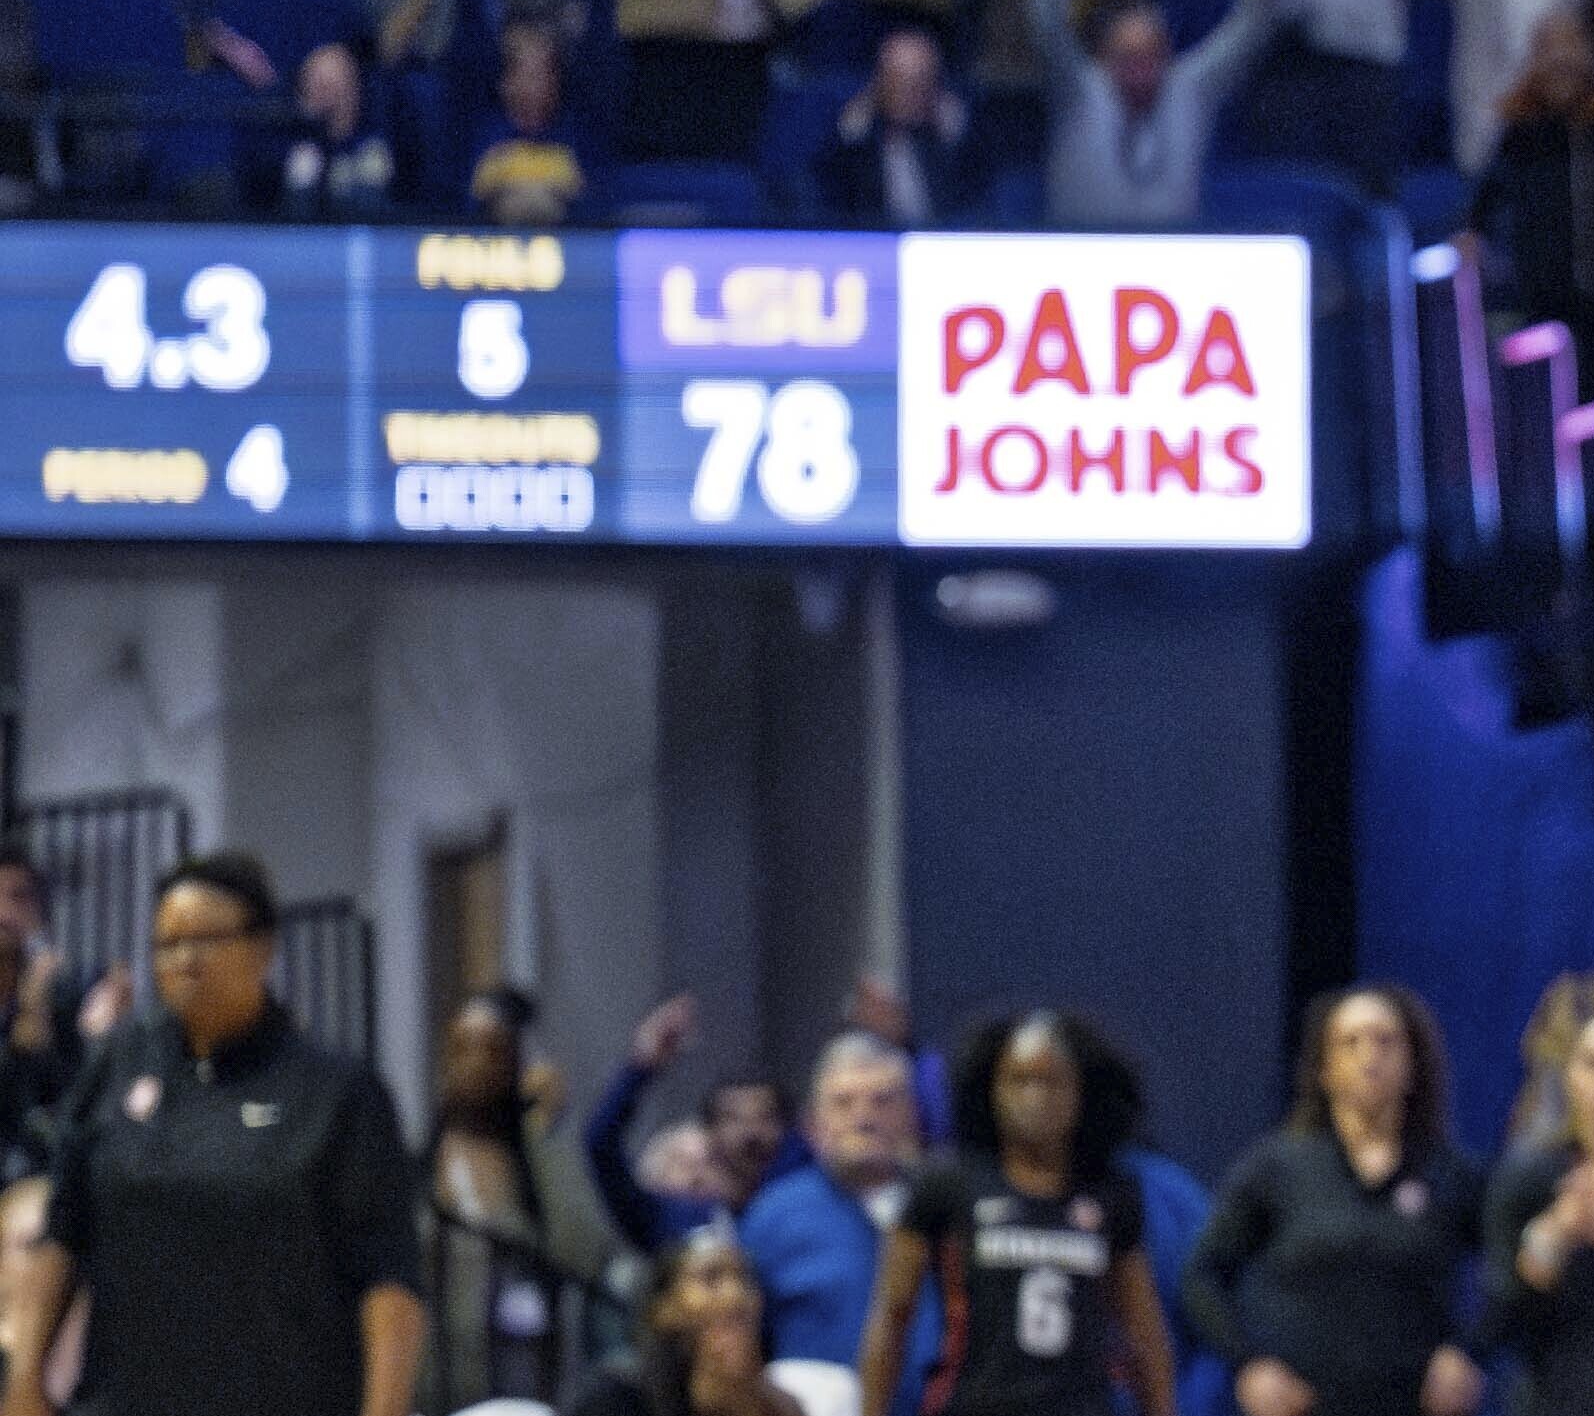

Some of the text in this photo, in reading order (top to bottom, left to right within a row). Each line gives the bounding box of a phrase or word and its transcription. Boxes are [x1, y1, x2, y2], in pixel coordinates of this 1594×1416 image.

[65, 262, 271, 391] 4.3
[662, 265, 867, 348] LSU
[943, 285, 1257, 396] PAPA
[226, 424, 290, 512] 4
[682, 379, 860, 525] 78
[934, 424, 1264, 496] JOHNS
